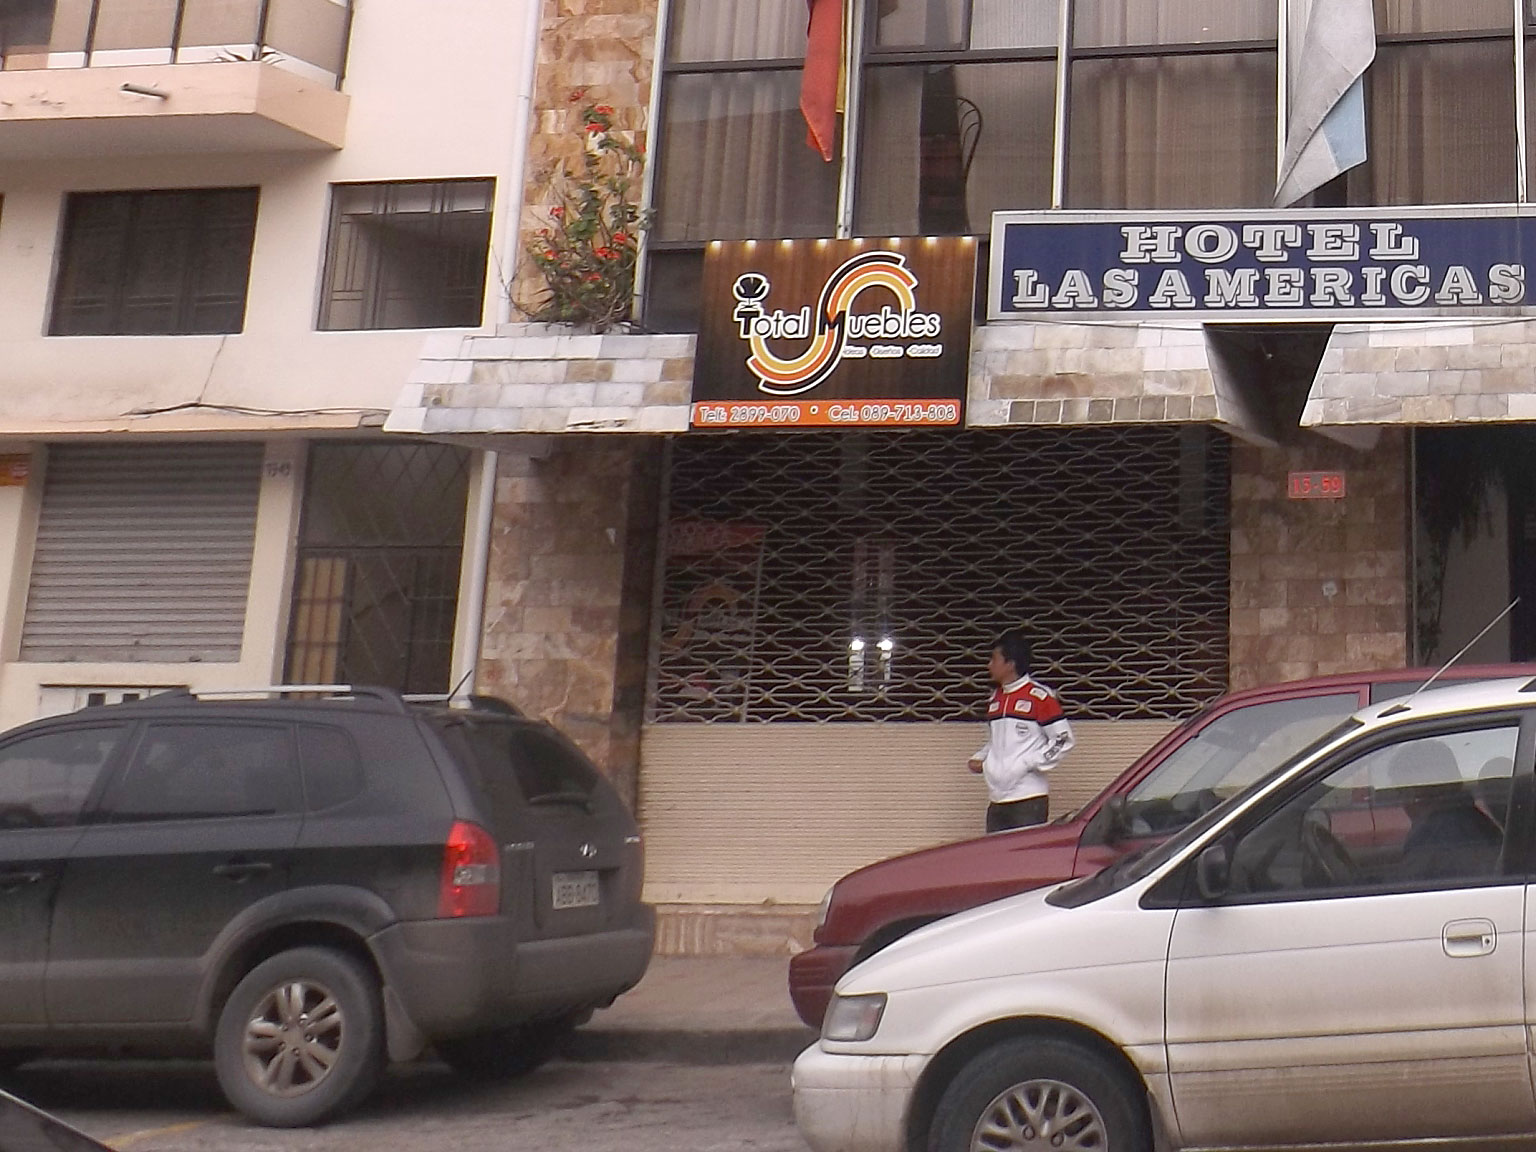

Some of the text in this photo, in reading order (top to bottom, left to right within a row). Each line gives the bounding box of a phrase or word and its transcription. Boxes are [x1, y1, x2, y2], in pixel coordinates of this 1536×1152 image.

[1119, 222, 1419, 264] HOTEL
[1012, 264, 1526, 309] LAS AMERICAS
[735, 307, 810, 339] Total
[730, 405, 800, 423] 2899-070
